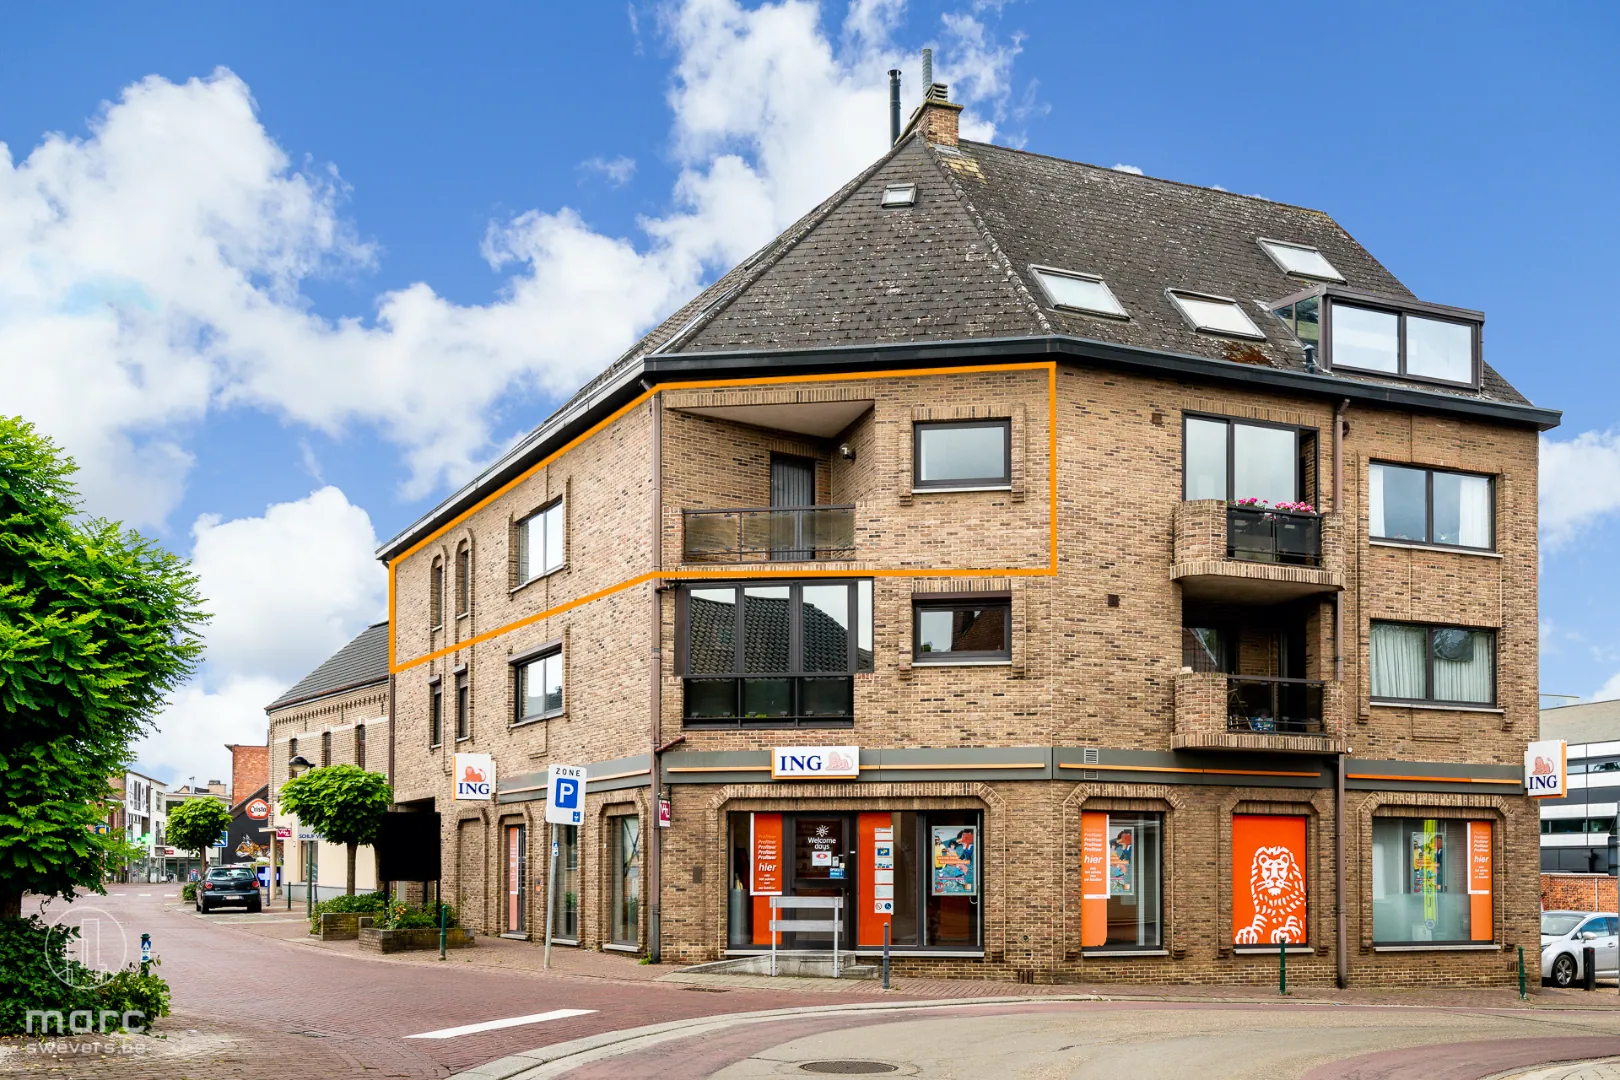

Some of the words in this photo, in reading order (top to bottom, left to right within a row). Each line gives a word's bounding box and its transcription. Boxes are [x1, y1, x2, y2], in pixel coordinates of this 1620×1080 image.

[780, 755, 822, 771] ING
[555, 767, 581, 777] ZONE
[458, 782, 490, 795] ING
[1529, 776, 1557, 789] ING
[559, 782, 574, 804] P
[1084, 855, 1102, 864] hier
[758, 862, 776, 872] hier
